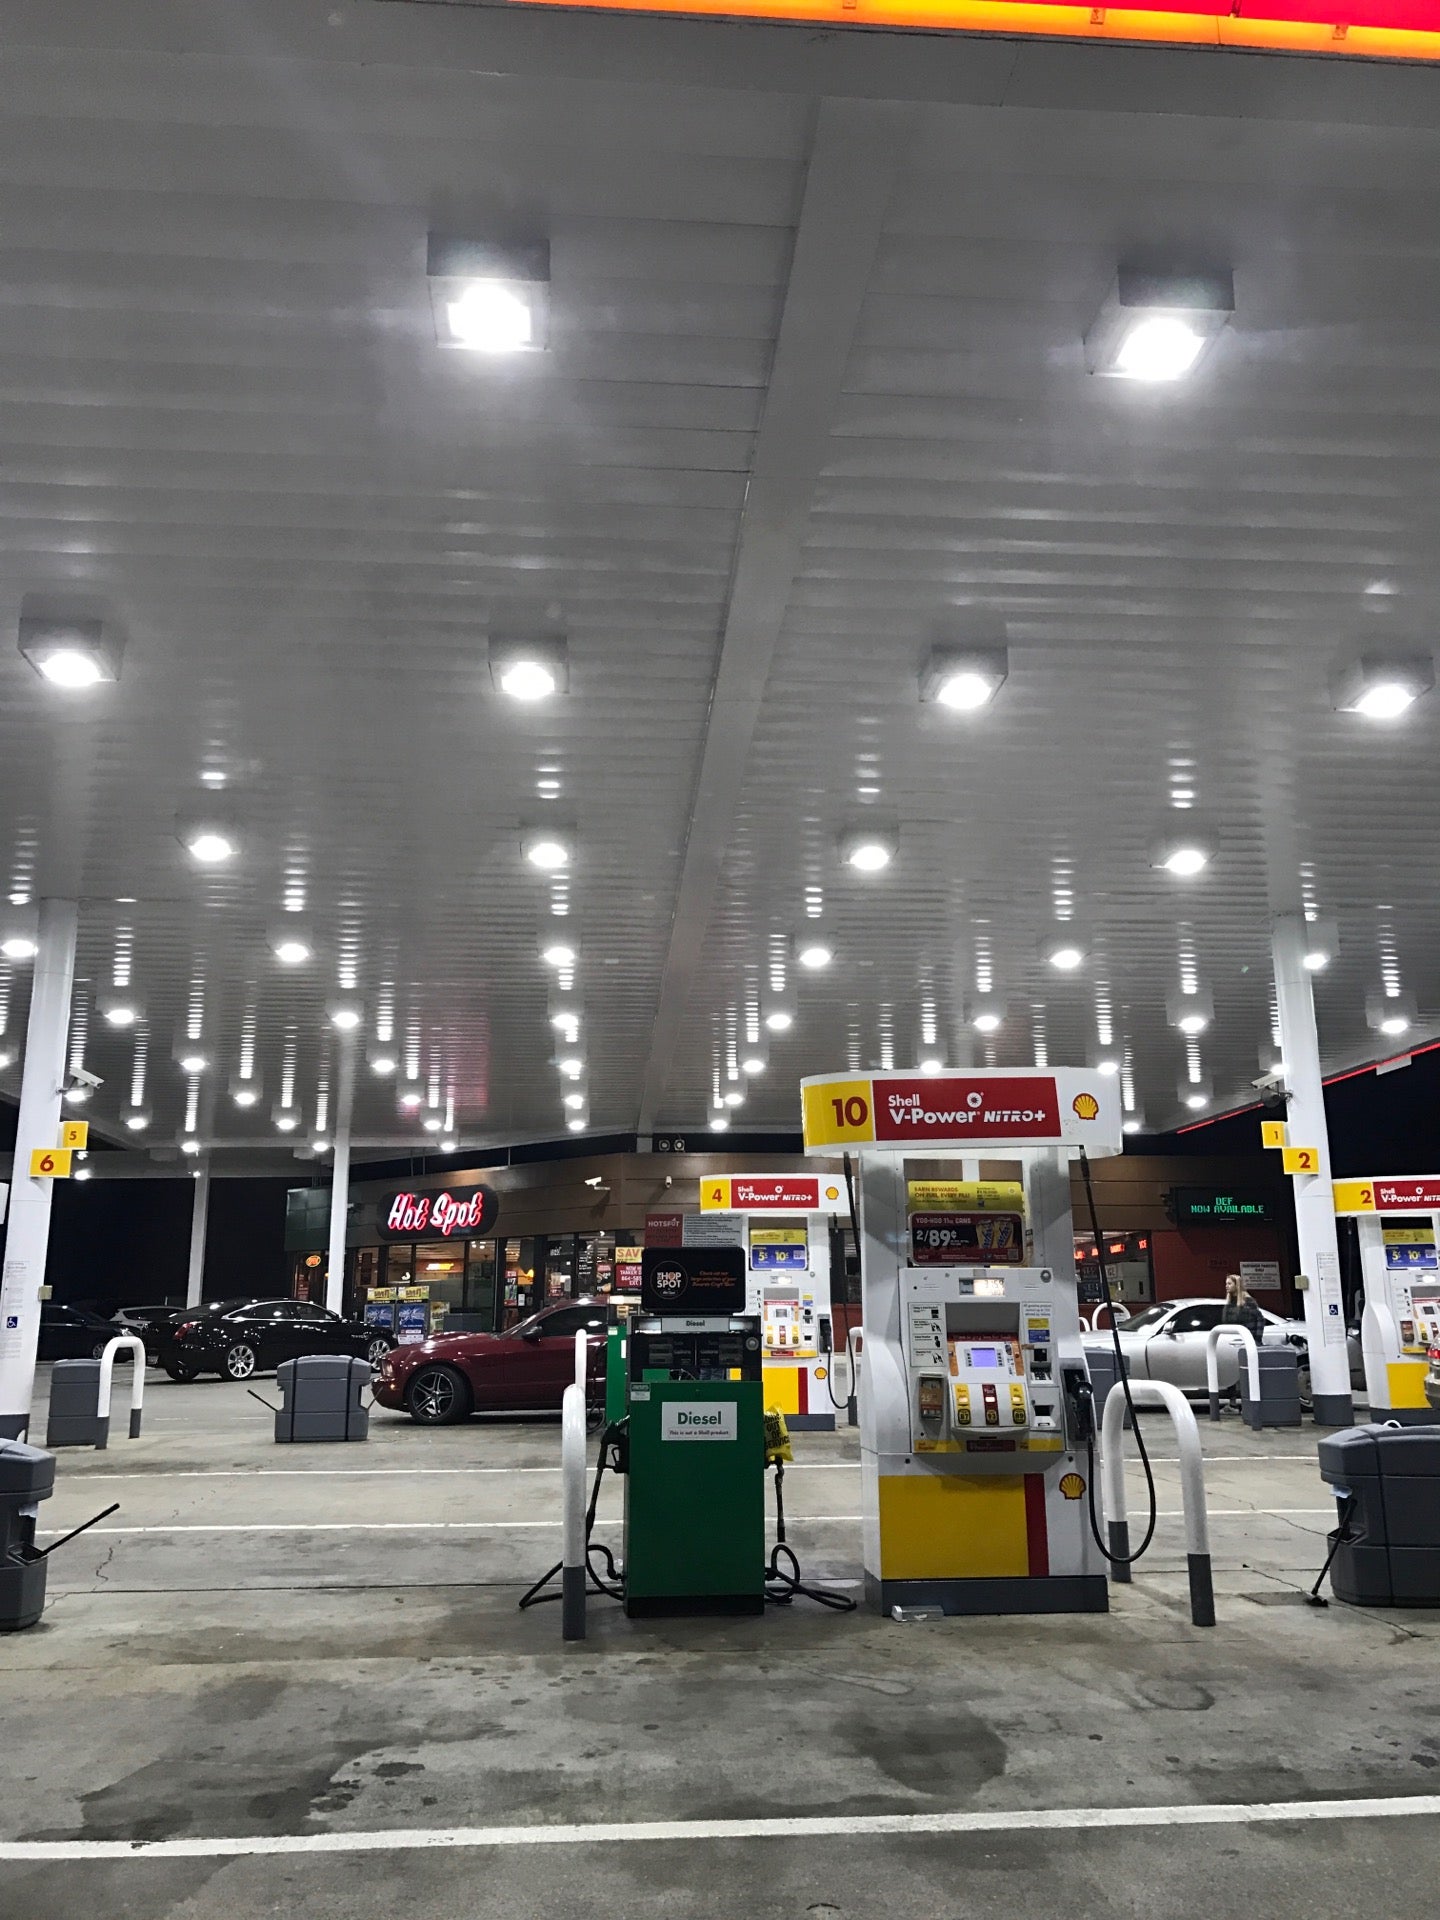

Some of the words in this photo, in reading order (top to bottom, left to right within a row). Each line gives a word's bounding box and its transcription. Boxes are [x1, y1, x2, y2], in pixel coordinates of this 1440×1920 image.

[888, 1094, 920, 1107] Shell
[832, 1096, 868, 1127] 10
[889, 1108, 977, 1124] V-Power
[69, 1131, 77, 1140] 5
[1274, 1131, 1279, 1139] 1
[40, 1155, 54, 1172] 6
[1298, 1152, 1311, 1168] 2
[712, 1188, 722, 1202] 4
[738, 1193, 779, 1201] V-Power
[1360, 1190, 1372, 1204] 2
[1382, 1195, 1422, 1203] V-Power
[1216, 1197, 1232, 1206] DEF
[388, 1192, 429, 1230] Hot
[430, 1191, 483, 1236] Spot
[1191, 1205, 1210, 1214] NOW
[1213, 1205, 1264, 1214] AVAILABLE
[617, 1248, 642, 1258] SAV
[662, 1272, 681, 1280] HOP
[657, 1280, 681, 1288] SPOT
[678, 1411, 721, 1425] Diesel
